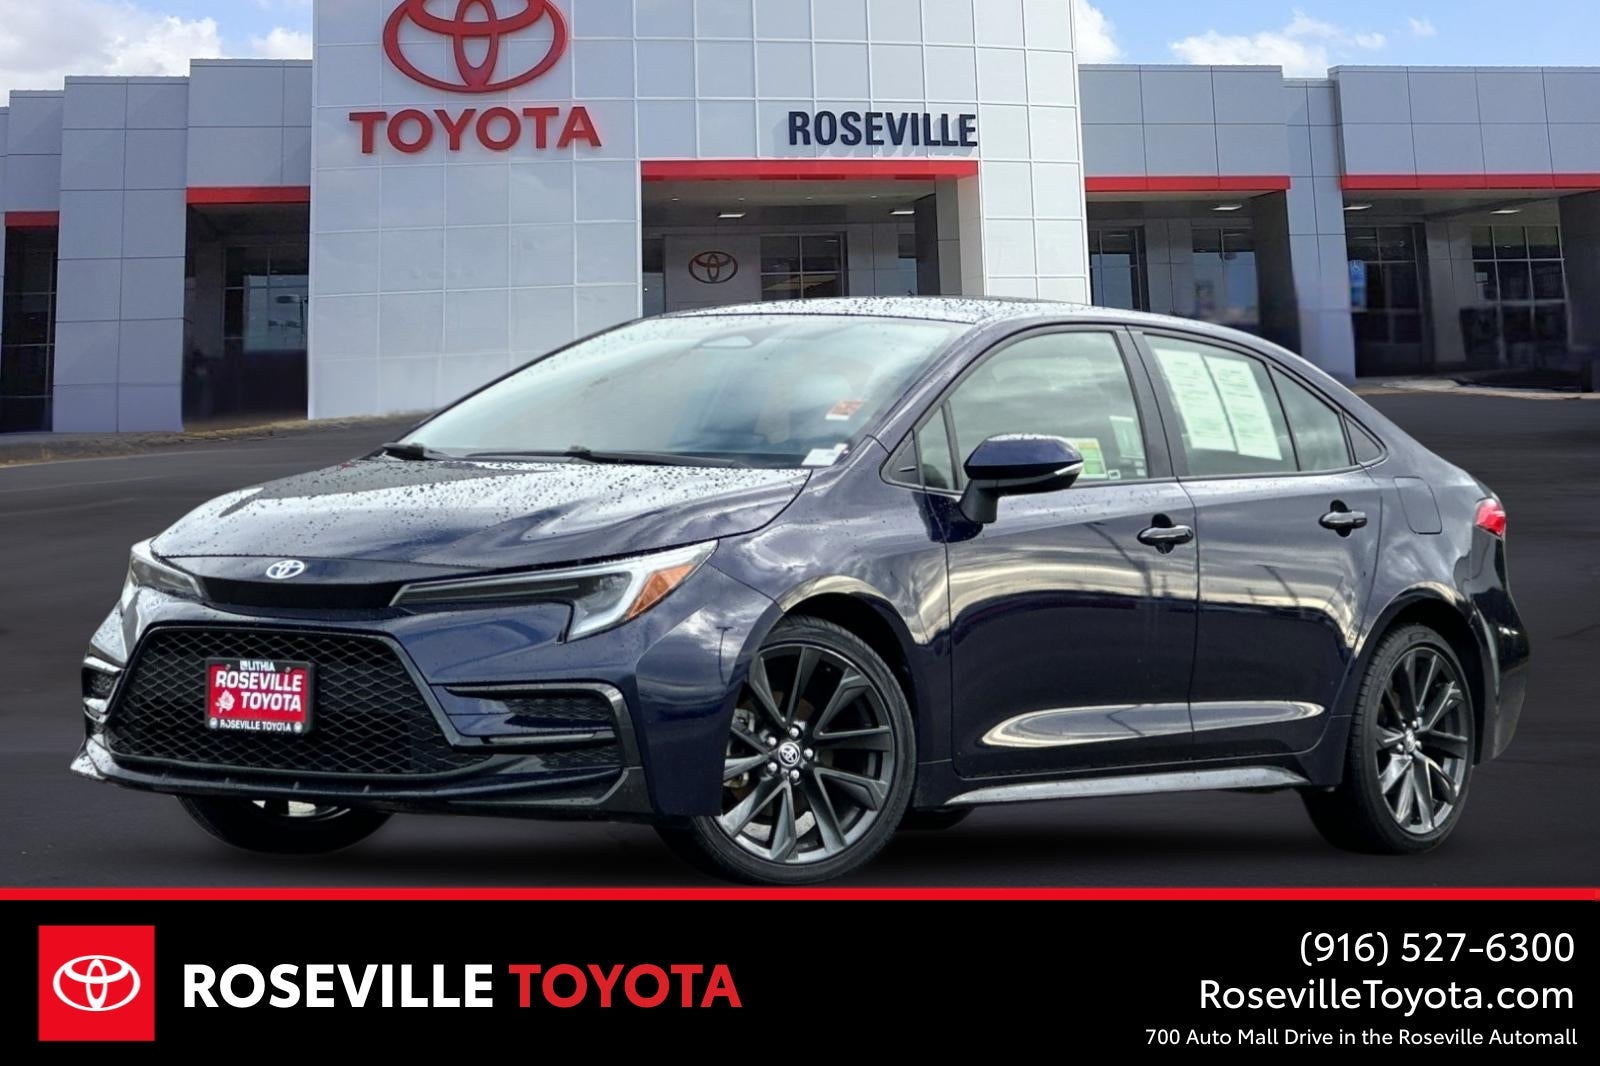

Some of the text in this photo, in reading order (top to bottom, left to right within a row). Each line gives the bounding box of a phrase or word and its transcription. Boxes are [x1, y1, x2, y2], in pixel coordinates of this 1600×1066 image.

[349, 106, 602, 154] TOYOTA
[788, 110, 978, 147] ROSEVILLE
[215, 671, 302, 692] ROSEVILLE
[241, 691, 302, 712] TOYOTA
[220, 719, 292, 732] ROSEVILLE TOYOTA
